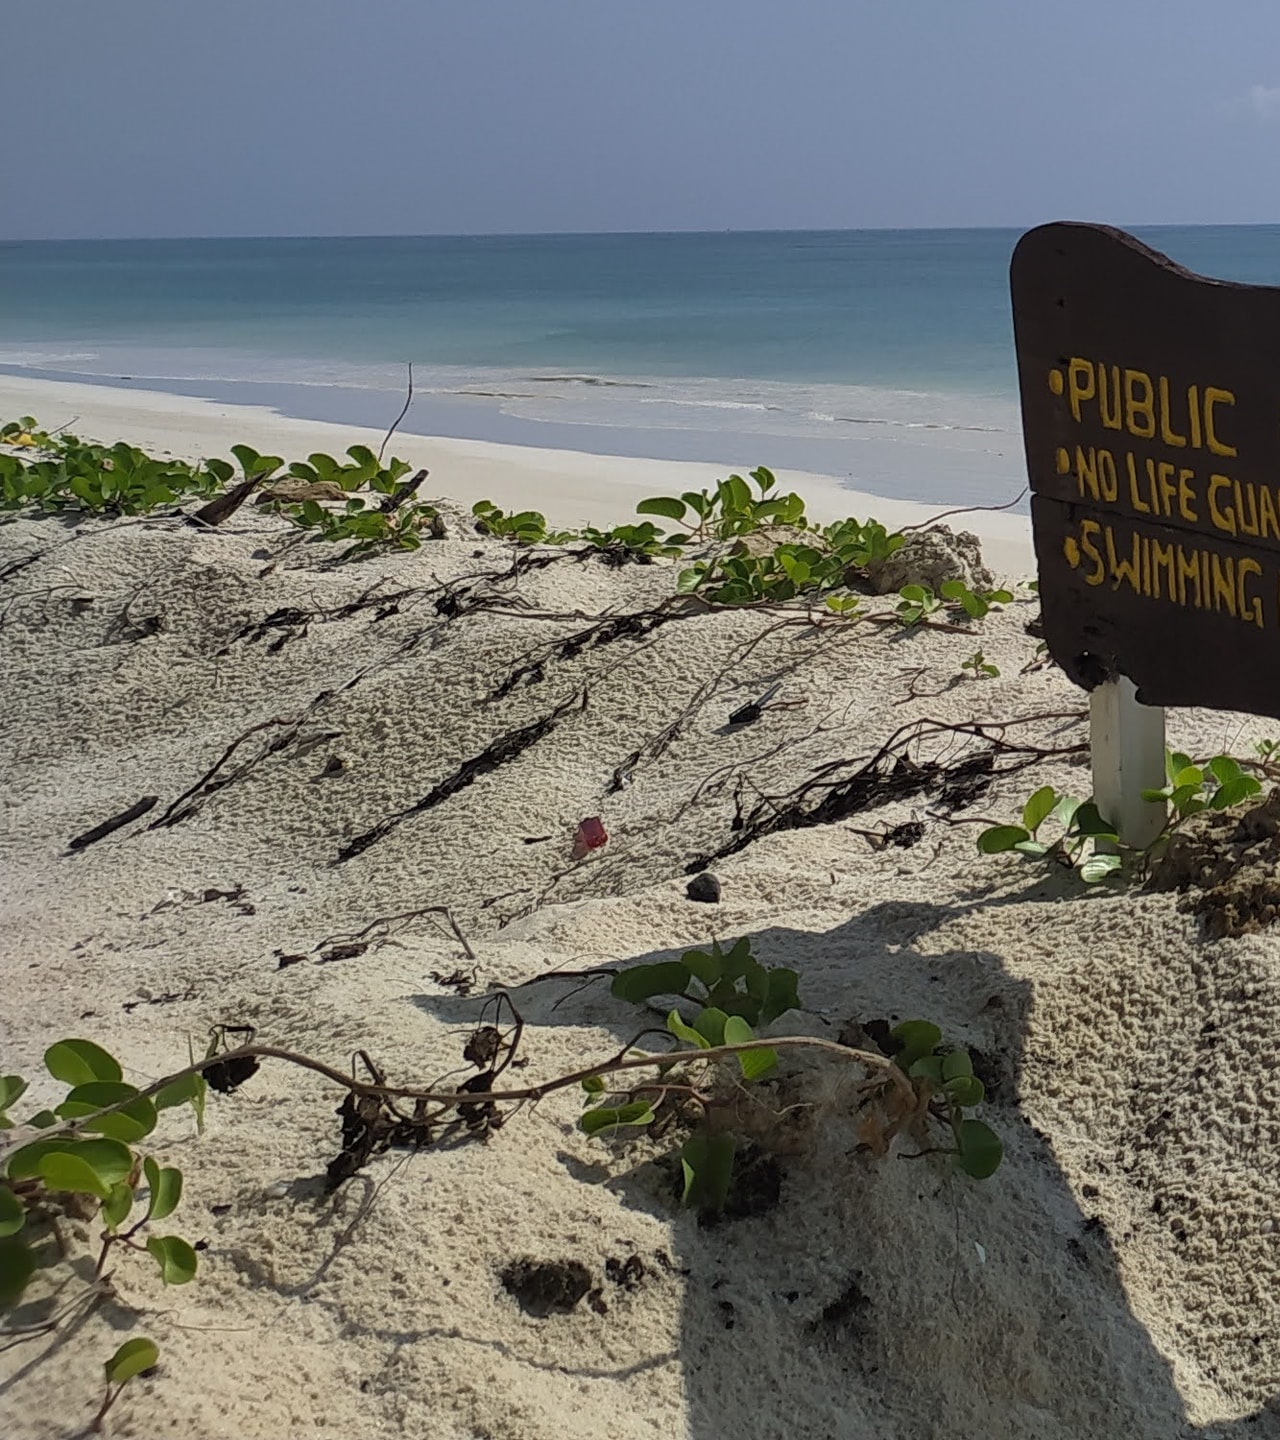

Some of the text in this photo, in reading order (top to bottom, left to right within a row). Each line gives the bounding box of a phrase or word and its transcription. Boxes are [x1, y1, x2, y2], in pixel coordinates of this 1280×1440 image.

[1068, 357, 1237, 457] PUBLIC
[1074, 446, 1118, 502] NO
[1127, 453, 1198, 522] LIFE
[1080, 520, 1264, 628] SWIMMING
